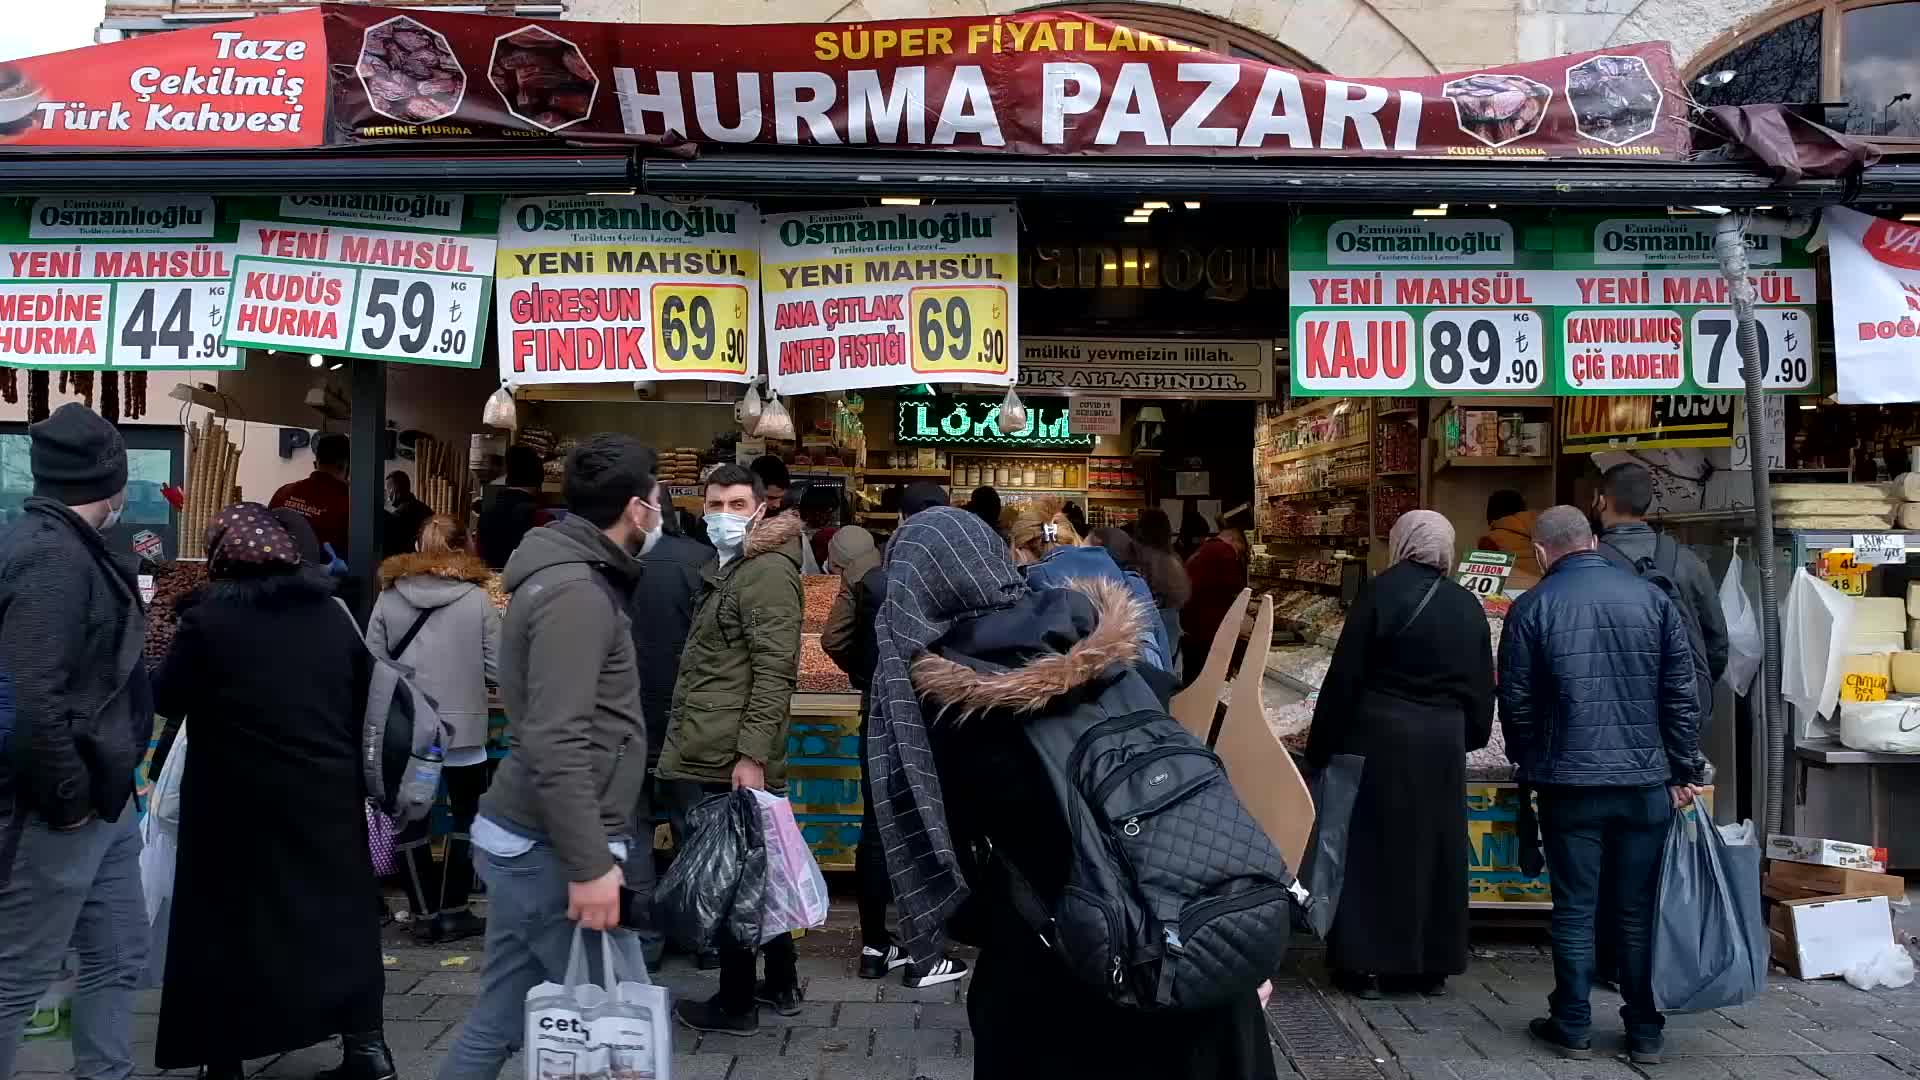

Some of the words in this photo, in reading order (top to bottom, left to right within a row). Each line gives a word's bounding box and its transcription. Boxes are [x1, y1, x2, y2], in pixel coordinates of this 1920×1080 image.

[211, 32, 306, 62] Taze
[814, 24, 953, 61] SÜPER
[130, 67, 304, 104] Çekilmiş
[36, 102, 130, 131] Türk
[144, 103, 304, 132] Kahvesi
[612, 65, 1006, 147] HURMA
[1042, 62, 1422, 151] PAZARI
[363, 125, 417, 137] MEDİNE
[421, 126, 472, 136] HURMA
[1498, 147, 1547, 156] HURMA
[1613, 147, 1661, 156] HURMA
[40, 206, 203, 229] Osmanlıoğlu
[516, 203, 737, 238] Osmanlıoğlu
[779, 211, 993, 248] Osmanlıoğlu
[1358, 224, 1420, 234] Eminönü
[259, 228, 329, 260] YENİ
[340, 236, 475, 273] MAHSÜL
[1336, 231, 1502, 255] Osmanlıoğlu
[1880, 227, 1920, 254] VA
[10, 246, 81, 277] YENİ
[94, 245, 230, 277] MAHSÜL
[607, 250, 746, 276] MAHSÜL
[865, 254, 1003, 283] MAHSÜL
[209, 287, 225, 296] KG
[245, 271, 342, 306] KUDÜS
[451, 281, 467, 291] KG
[1309, 272, 1383, 304] YENİ
[1396, 272, 1534, 304] MAHSÜL
[1576, 272, 1650, 303] YENİ
[0, 288, 103, 321] MEDİNE
[362, 278, 435, 353] 59
[510, 282, 641, 324] GİRESUN
[775, 300, 819, 330] ANA
[823, 294, 904, 331] ÇITLAK
[1513, 313, 1529, 322] KG
[1782, 312, 1798, 321] KG
[121, 288, 195, 359] 44
[237, 304, 338, 339] HURMA
[662, 295, 715, 361] 69
[918, 296, 971, 361] 69
[1567, 317, 1682, 349] KAVRULMUŞ
[1859, 315, 1920, 340] BOĞ
[513, 327, 648, 372] FINDIK
[779, 337, 835, 376] ANTEP
[839, 325, 906, 369] FISTIĞI
[1025, 347, 1081, 359] mülkü
[1088, 348, 1177, 362] yevmeizin
[1306, 321, 1407, 379] KAJU
[1430, 319, 1501, 385] 89
[1571, 348, 1605, 386] ÇİĞ
[1611, 353, 1679, 379] BADEM
[1464, 576, 1493, 593] 40
